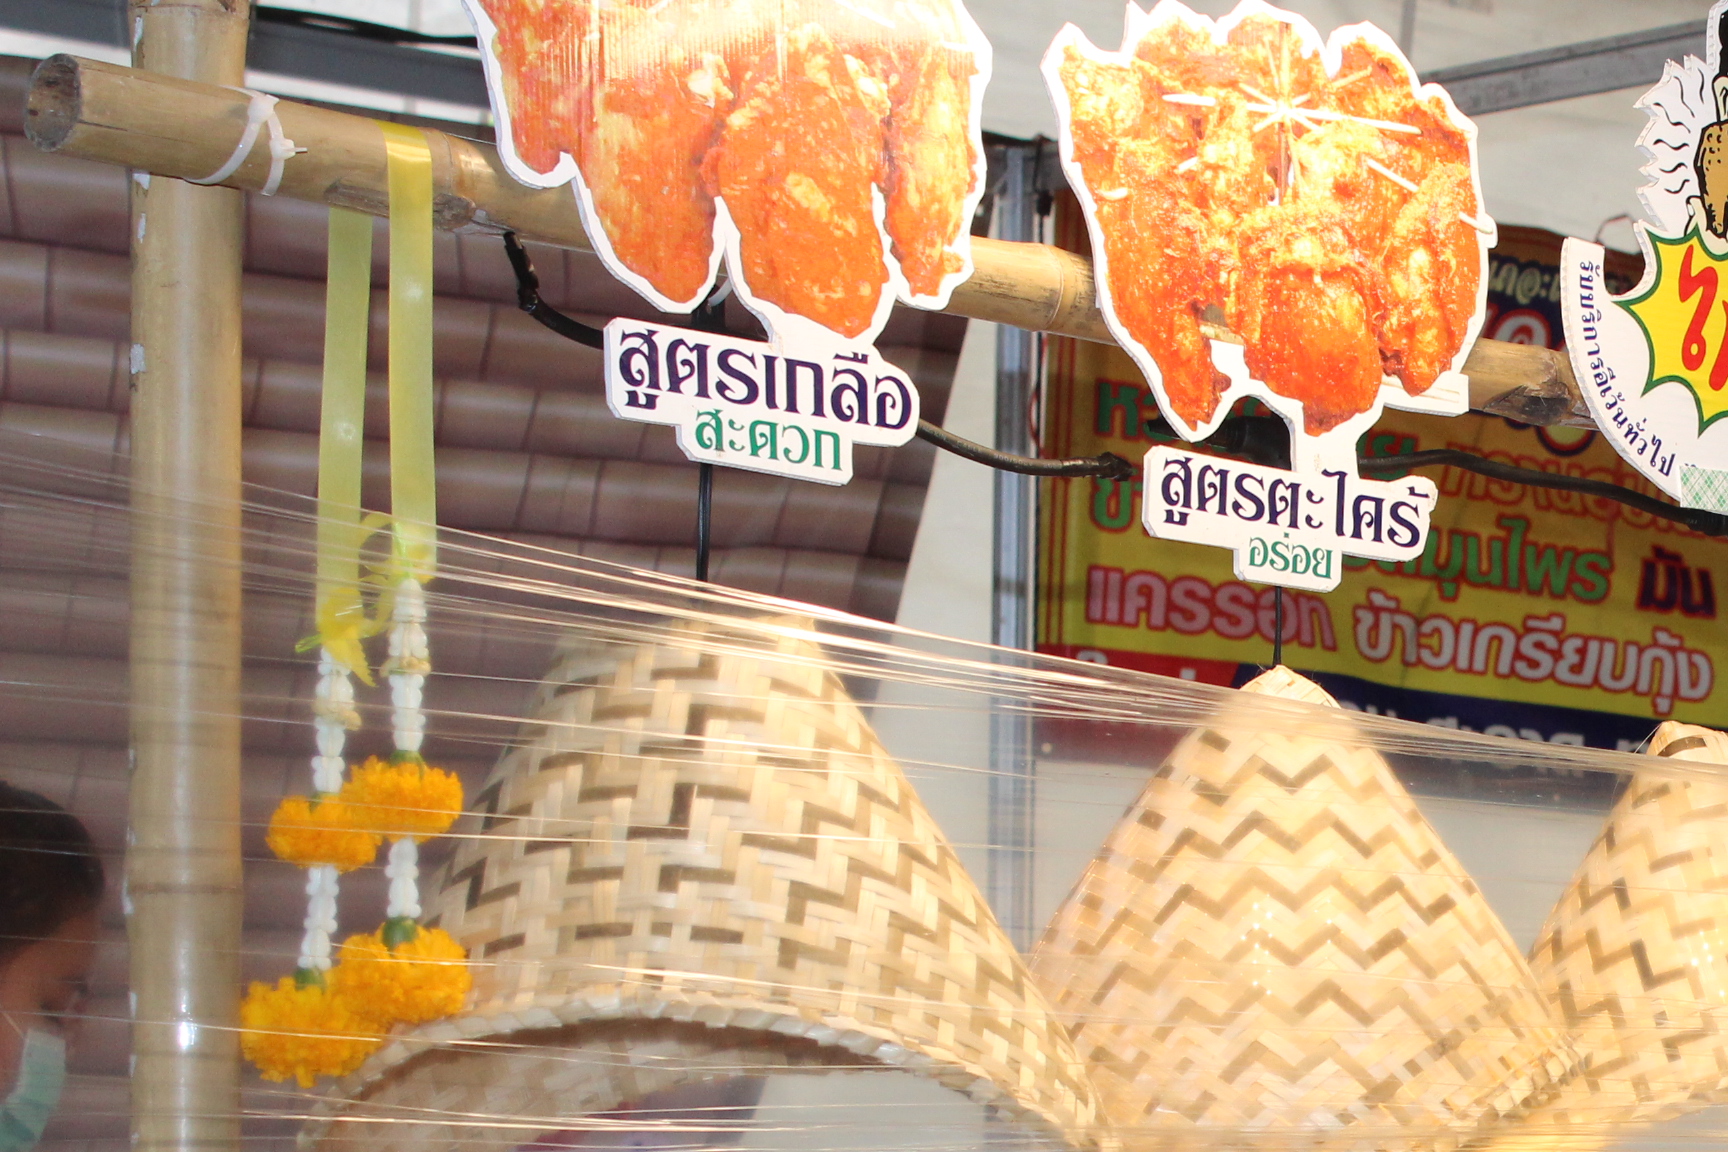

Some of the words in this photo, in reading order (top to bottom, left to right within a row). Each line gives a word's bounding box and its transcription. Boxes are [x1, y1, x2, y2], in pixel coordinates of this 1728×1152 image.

[618, 328, 913, 431] สูตรเกลือ
[695, 407, 843, 471] สะดวก
[1161, 456, 1430, 548] สูตรตะไคร้
[1247, 533, 1334, 581] อร่อย
[1354, 588, 1713, 716] ข้าวเกรียบกุ้ง
